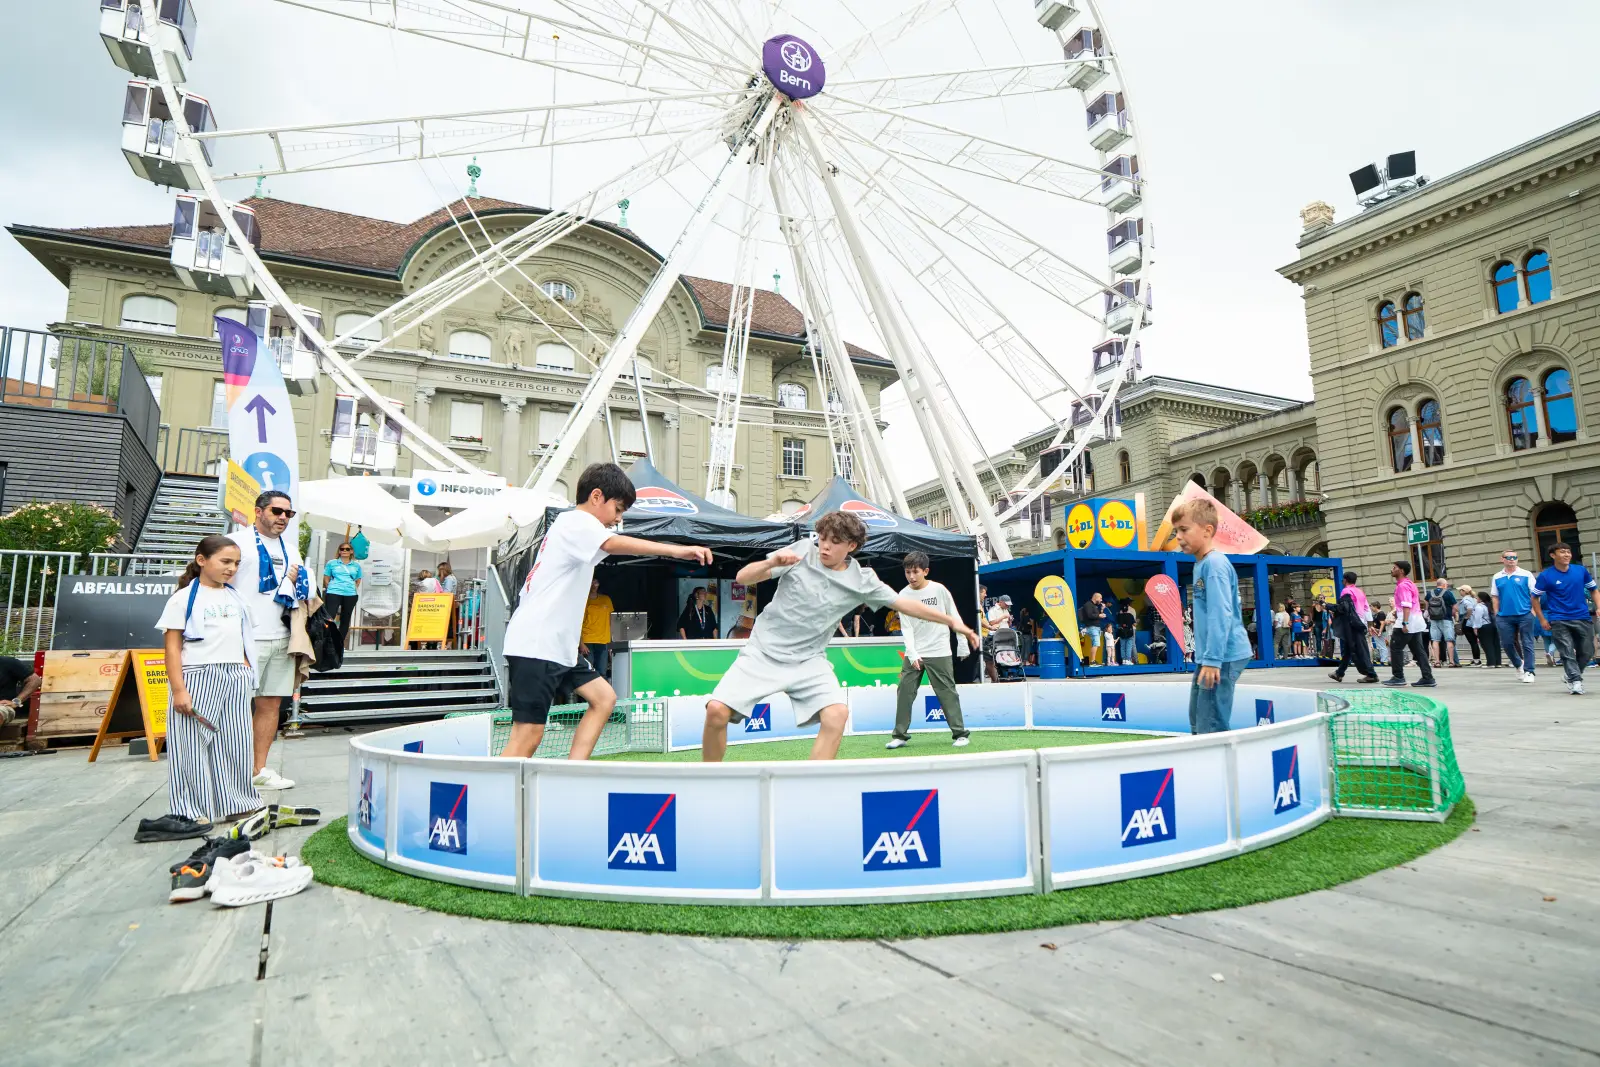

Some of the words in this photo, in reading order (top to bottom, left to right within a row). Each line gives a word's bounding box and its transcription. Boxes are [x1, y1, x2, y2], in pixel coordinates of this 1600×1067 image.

[780, 69, 811, 91] Bern
[160, 348, 222, 362] NATIONALE
[454, 374, 558, 393] SCHWEIZERISCHE
[634, 498, 694, 509] PEPSI
[857, 511, 893, 521] EPSI
[745, 717, 767, 730] AXA
[1102, 706, 1123, 721] AXA
[1274, 777, 1299, 810] AXA
[429, 817, 460, 848] AXA
[1122, 806, 1168, 842] AXA
[607, 832, 665, 864] AXA
[863, 831, 928, 864] AXA
